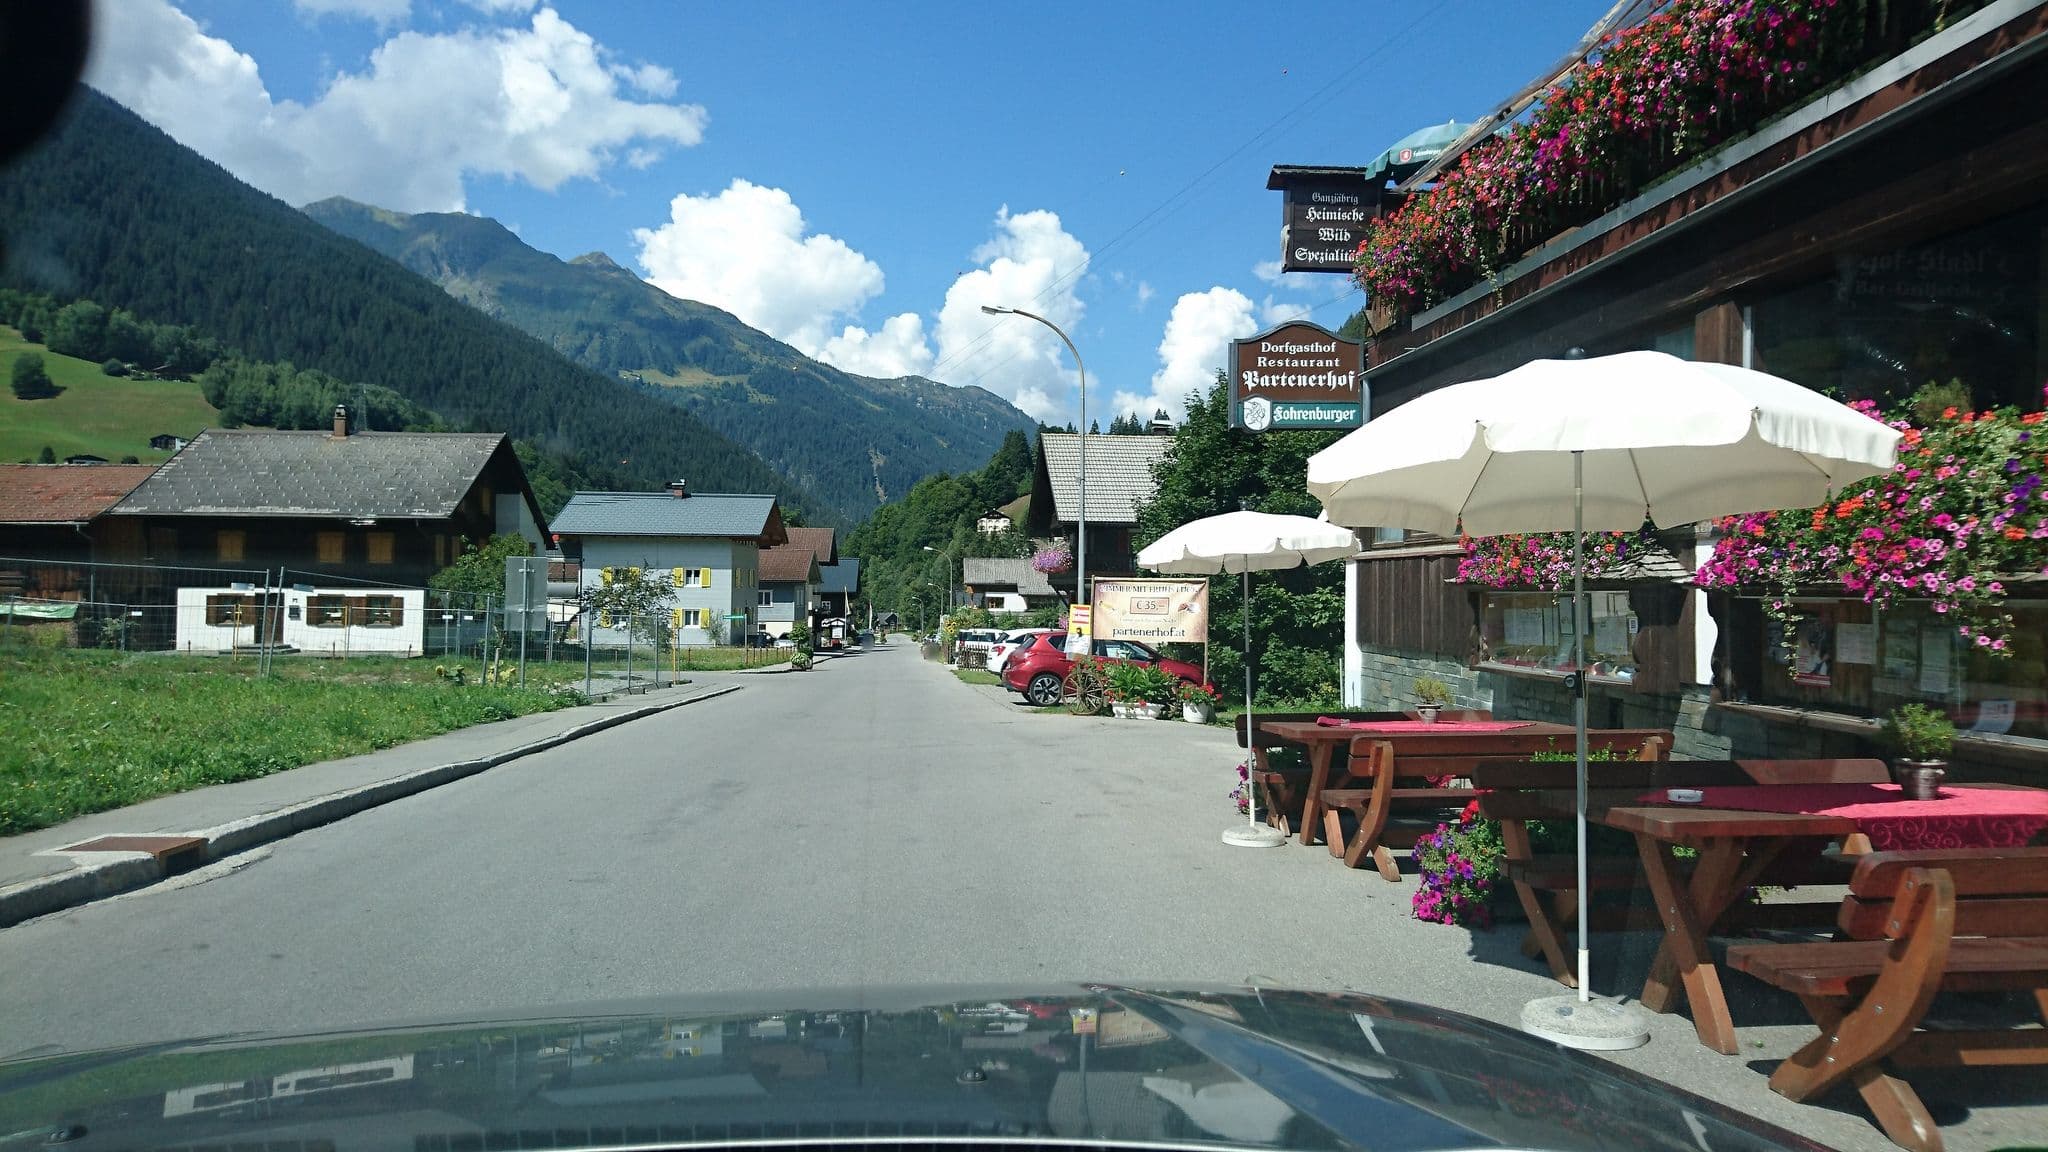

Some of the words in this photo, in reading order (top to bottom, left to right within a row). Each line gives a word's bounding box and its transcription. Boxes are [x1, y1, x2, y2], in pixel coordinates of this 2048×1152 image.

[1311, 192, 1359, 205] Ganzjährig
[1305, 207, 1364, 223] Heimische
[1318, 227, 1351, 242] Wild
[1261, 342, 1336, 355] Dorfgasthof
[1257, 356, 1341, 367] Restaurant
[1242, 370, 1355, 392] Partenerhof
[1273, 406, 1356, 422] Fohrenburger
[1112, 627, 1185, 638] partenerhof.at
